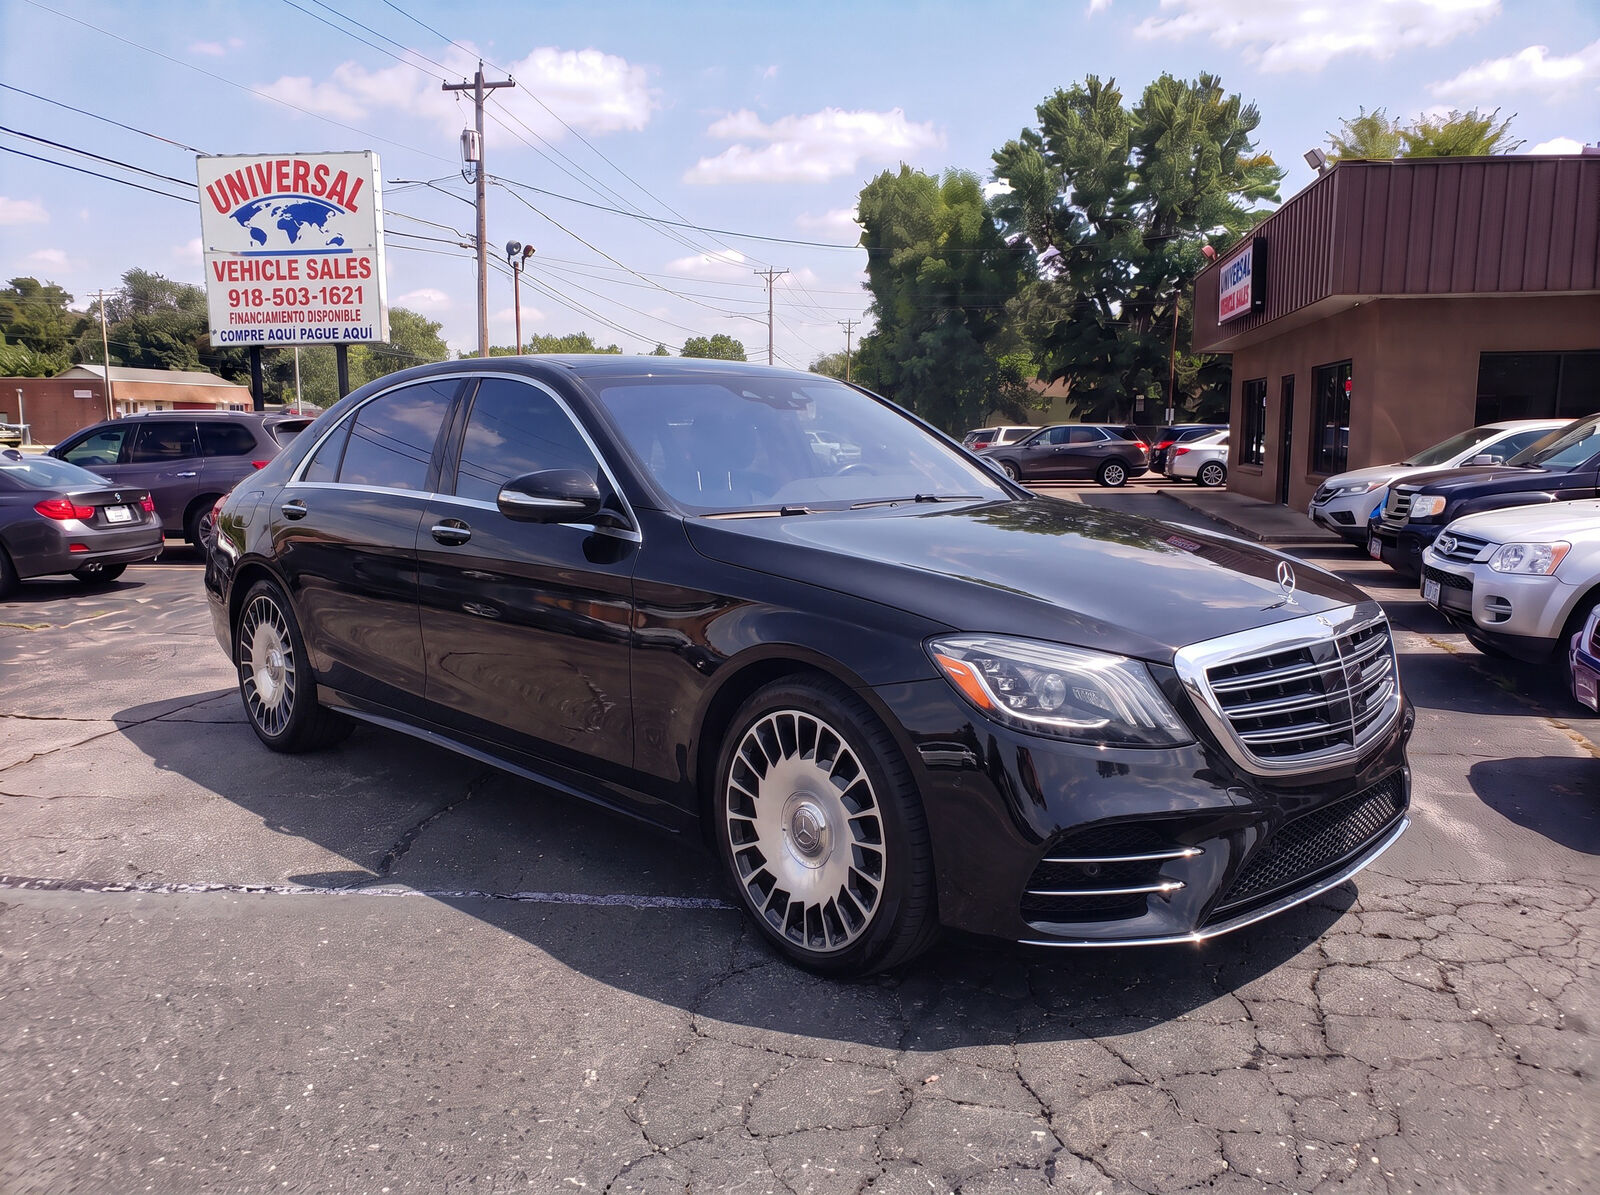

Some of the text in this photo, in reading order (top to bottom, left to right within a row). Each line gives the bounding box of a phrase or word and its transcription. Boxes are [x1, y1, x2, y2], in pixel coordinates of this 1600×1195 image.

[206, 160, 364, 214] UNIVERSAL
[213, 257, 372, 282] VEHICLE SALES
[228, 286, 363, 307] 918-503-1621
[229, 308, 361, 325] FINANCIAMIENTO DISPONIBLE
[220, 328, 264, 342] COMPRE
[300, 326, 339, 340] PAGUE
